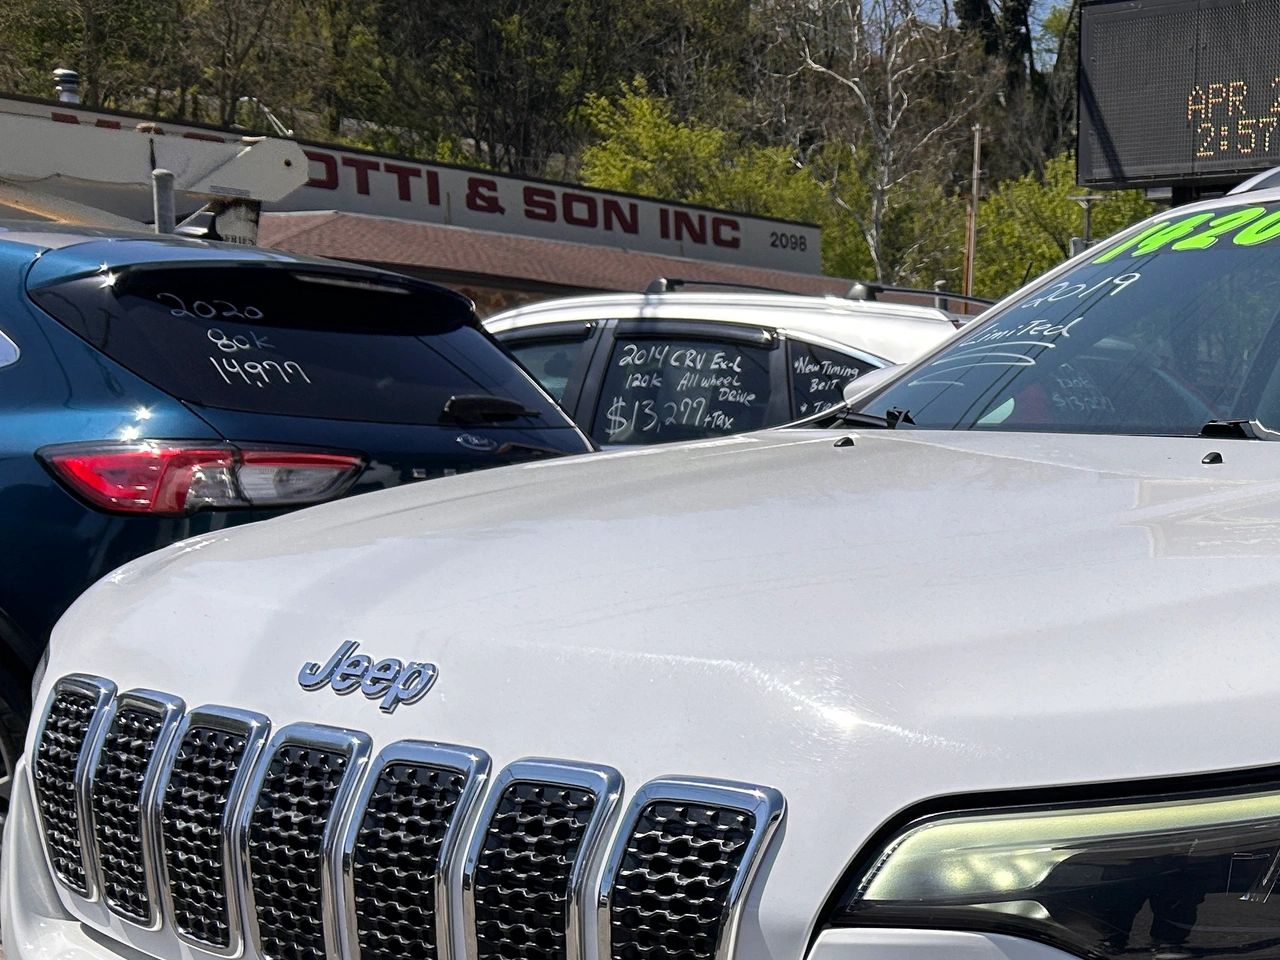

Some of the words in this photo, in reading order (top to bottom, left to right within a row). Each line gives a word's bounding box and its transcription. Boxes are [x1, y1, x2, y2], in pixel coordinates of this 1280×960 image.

[1187, 83, 1247, 120] APR
[304, 150, 440, 206] OTTI
[466, 176, 504, 214] &
[523, 185, 640, 235] SON
[659, 208, 741, 249] INC
[769, 231, 808, 252] 2098
[156, 292, 265, 319] 2020
[1021, 272, 1142, 309] 2019
[618, 344, 670, 368] 2014
[298, 640, 439, 714] Jeep
